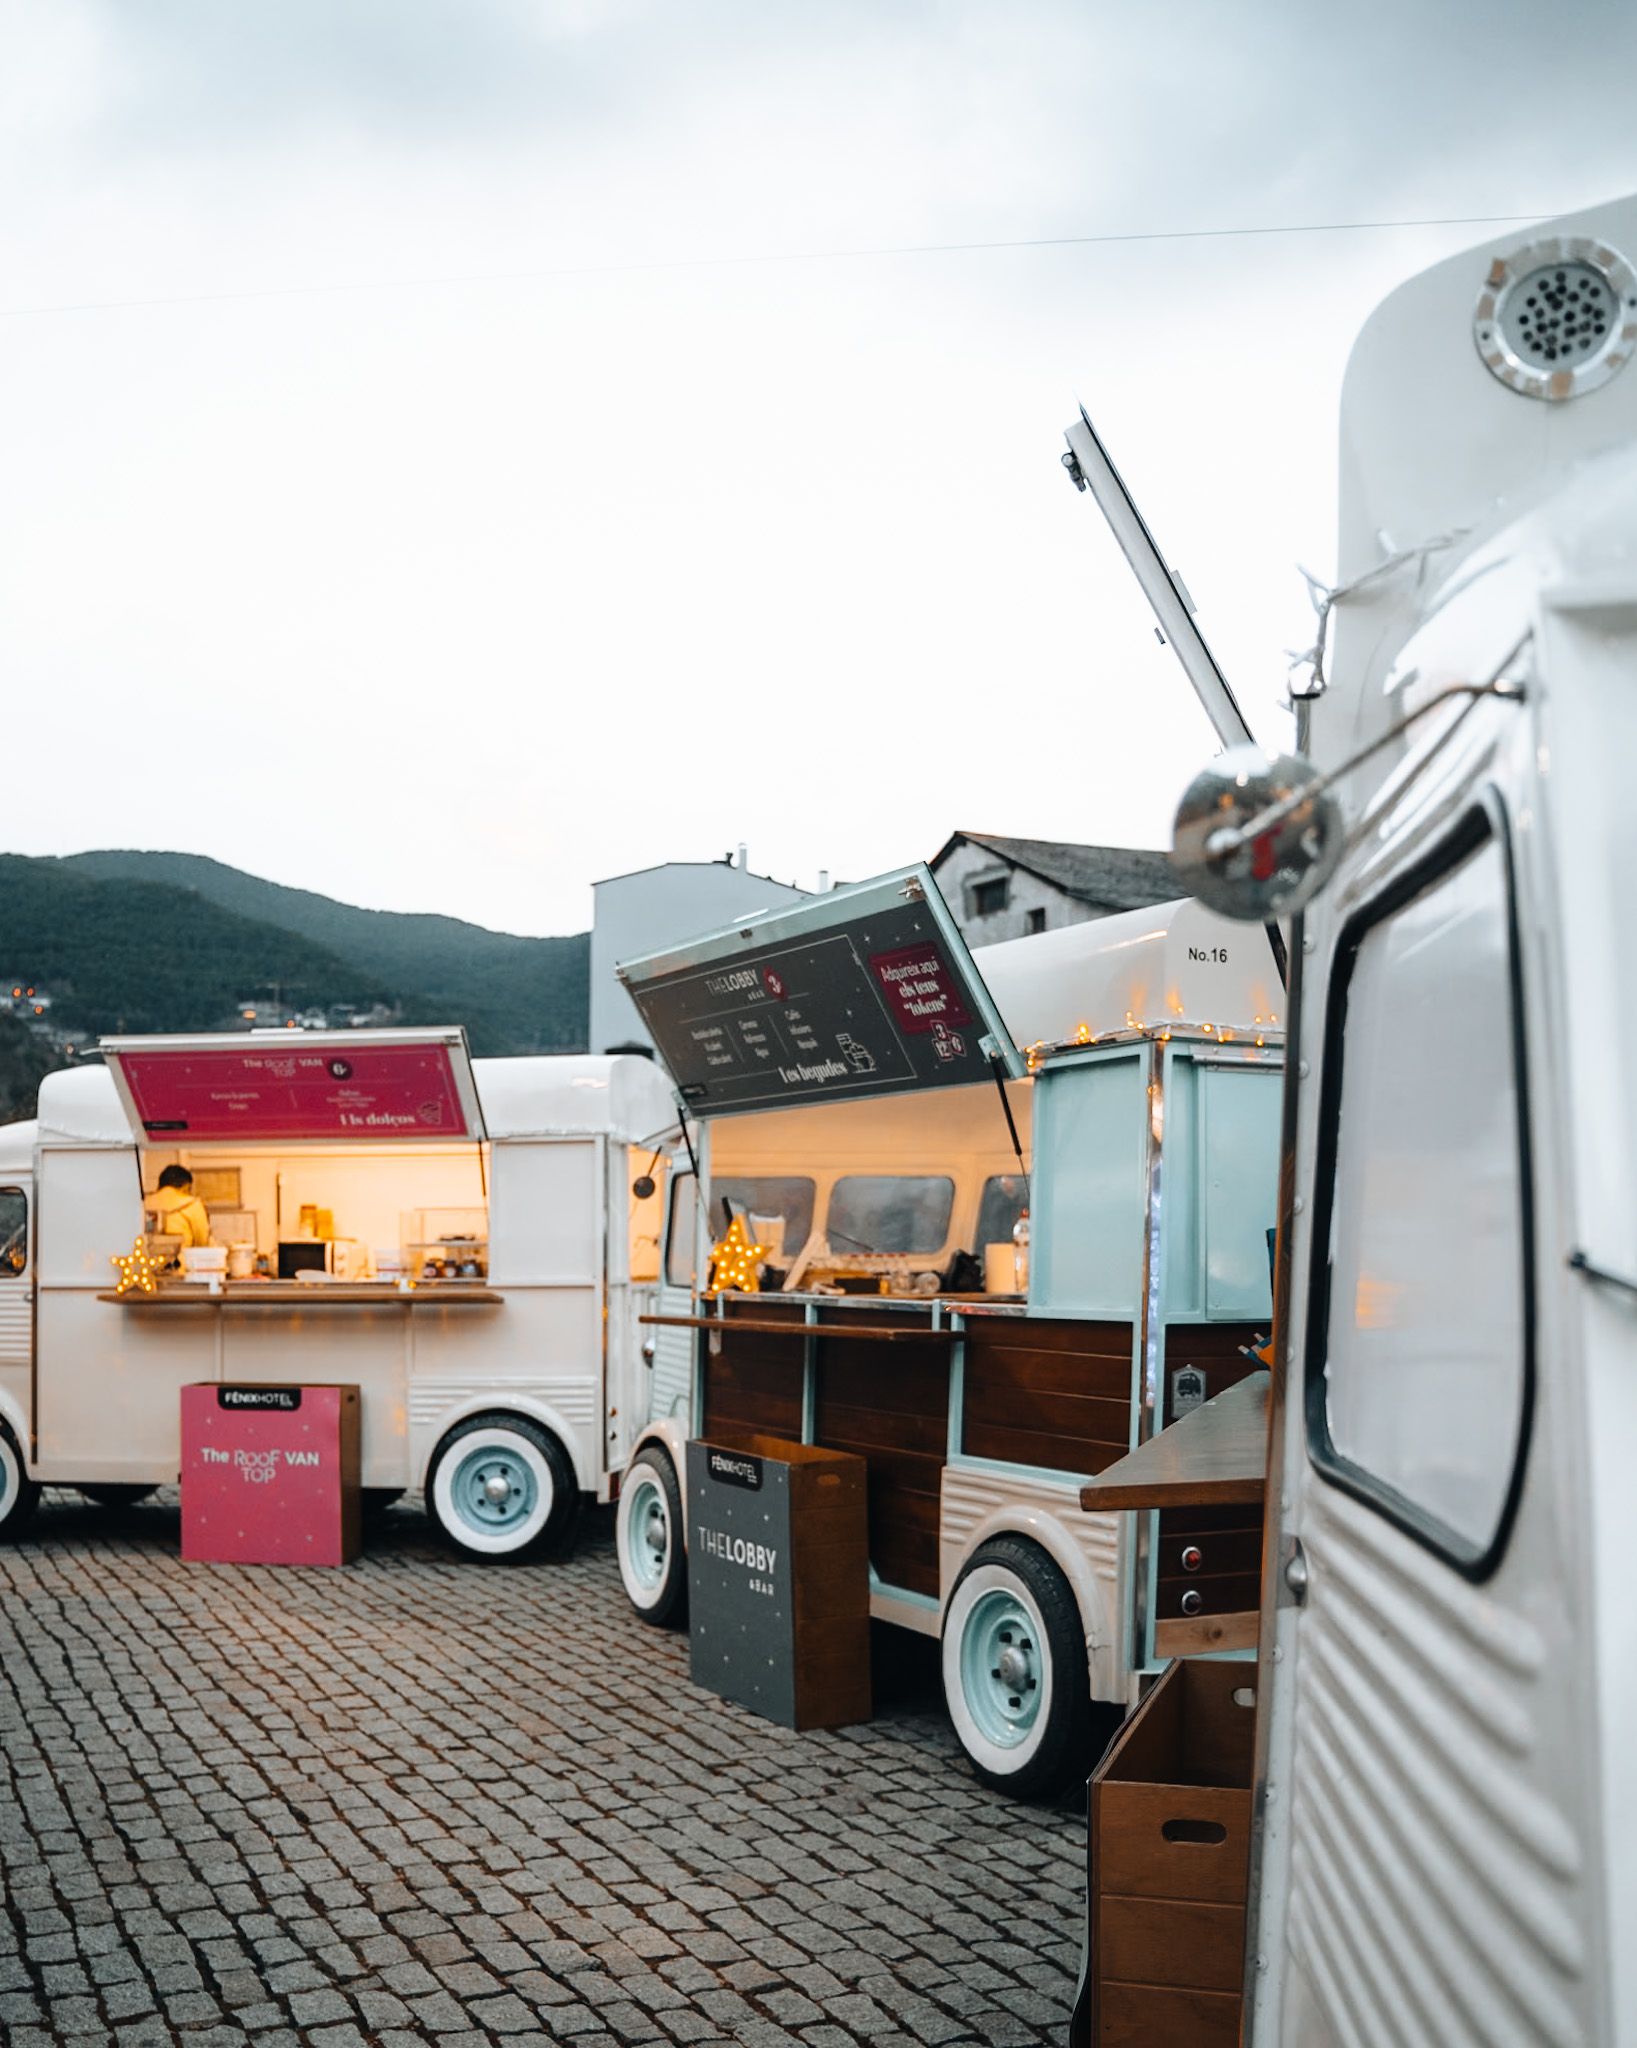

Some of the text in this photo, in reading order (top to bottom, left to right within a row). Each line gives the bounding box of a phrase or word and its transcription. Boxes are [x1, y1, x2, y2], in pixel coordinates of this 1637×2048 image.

[1188, 947, 1228, 963] No.16
[202, 1447, 320, 1467] The ROOF VAN
[241, 1466, 277, 1483] TOP
